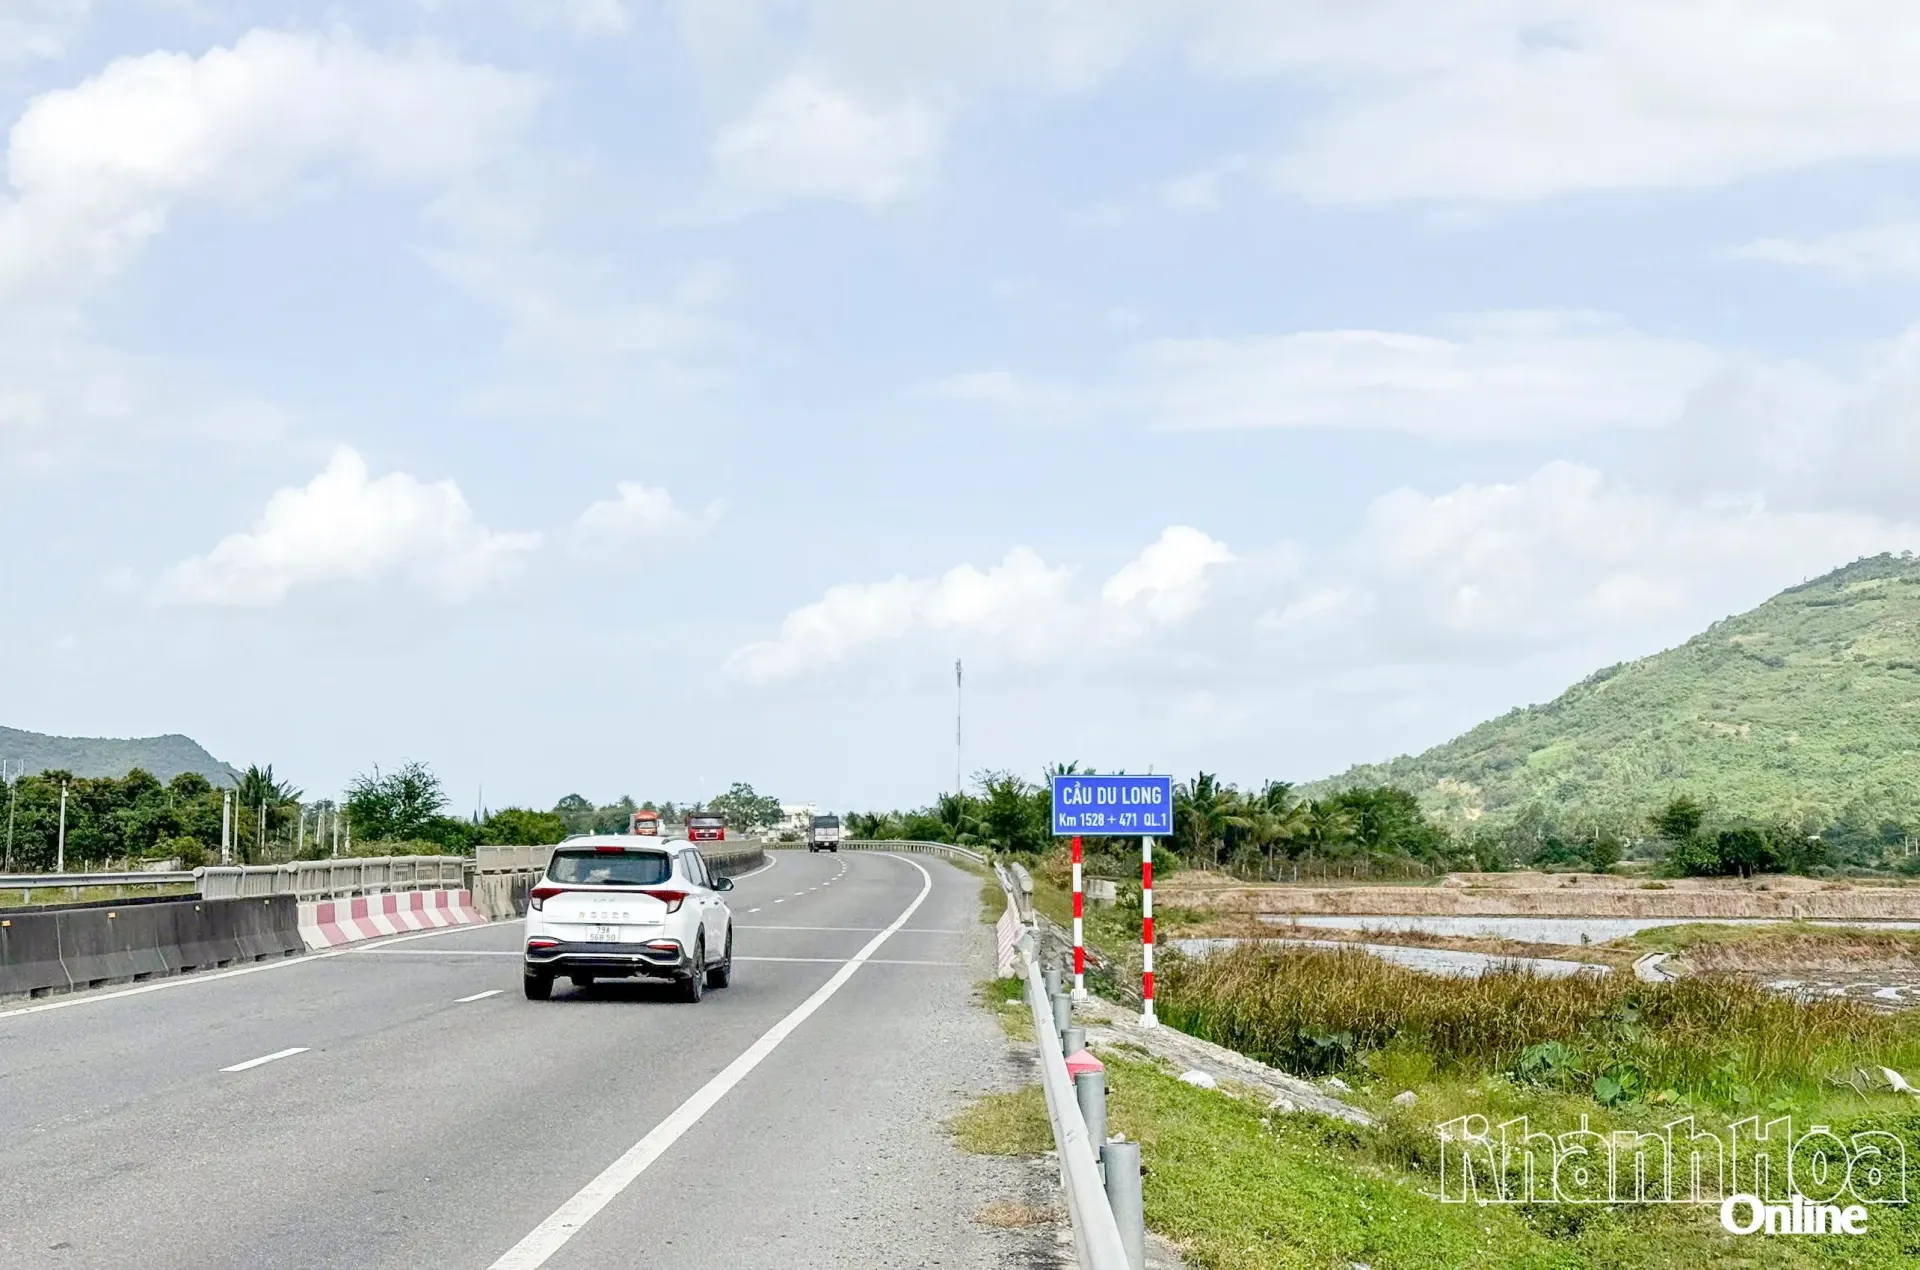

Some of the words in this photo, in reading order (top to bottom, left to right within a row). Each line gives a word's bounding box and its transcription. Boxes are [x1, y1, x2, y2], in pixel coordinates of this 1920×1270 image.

[1063, 781, 1092, 805] CẦU
[1097, 786, 1117, 805] DU
[1122, 786, 1162, 805] LONG
[1059, 813, 1076, 827] Km
[1080, 813, 1105, 827] 1528
[1107, 815, 1116, 825] +
[1119, 813, 1137, 827] 471
[1144, 813, 1167, 827] QL.1
